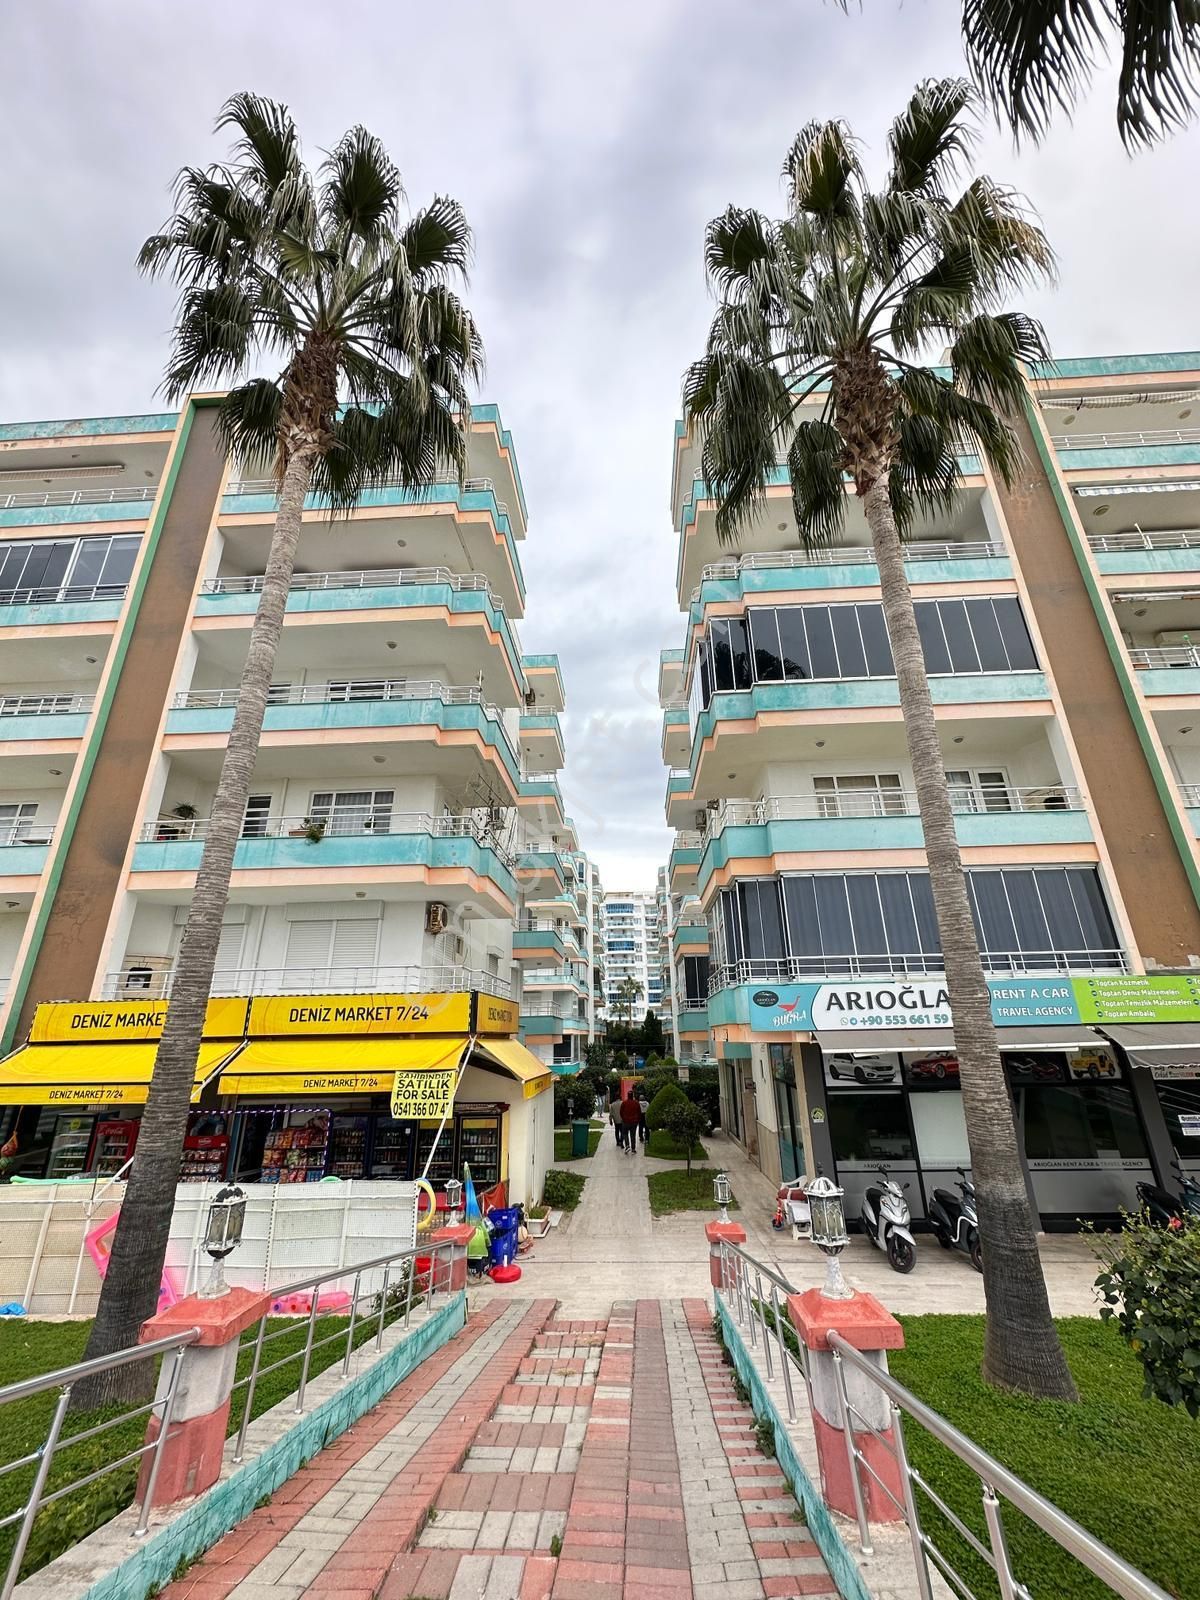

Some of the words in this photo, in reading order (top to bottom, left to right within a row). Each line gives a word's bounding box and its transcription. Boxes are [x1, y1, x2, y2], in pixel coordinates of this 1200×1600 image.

[992, 988, 1027, 1000] RENT
[1030, 988, 1040, 999] A
[1042, 987, 1071, 999] CAR
[289, 1003, 332, 1022] DENİZ
[334, 1005, 394, 1022] MARKET
[397, 1004, 429, 1021] 7/24
[996, 1007, 1034, 1018] TRAVEL
[1035, 1005, 1074, 1017] AGENCY
[71, 1010, 114, 1029] DENİZ
[114, 1011, 168, 1029] MARKE
[860, 1014, 883, 1026] +90
[885, 1014, 907, 1026] 553
[909, 1014, 931, 1025] 661
[933, 1013, 949, 1025] 59
[327, 1078, 360, 1088] MARKET
[360, 1078, 378, 1088] 7/24
[397, 1078, 450, 1090] SATILIK
[73, 1089, 105, 1099] MARKET
[105, 1089, 124, 1099] 7/24
[396, 1088, 419, 1100] FOR
[420, 1088, 449, 1100] SALE
[393, 1101, 411, 1117] 0541
[412, 1101, 427, 1117] 366
[428, 1101, 439, 1117] 07
